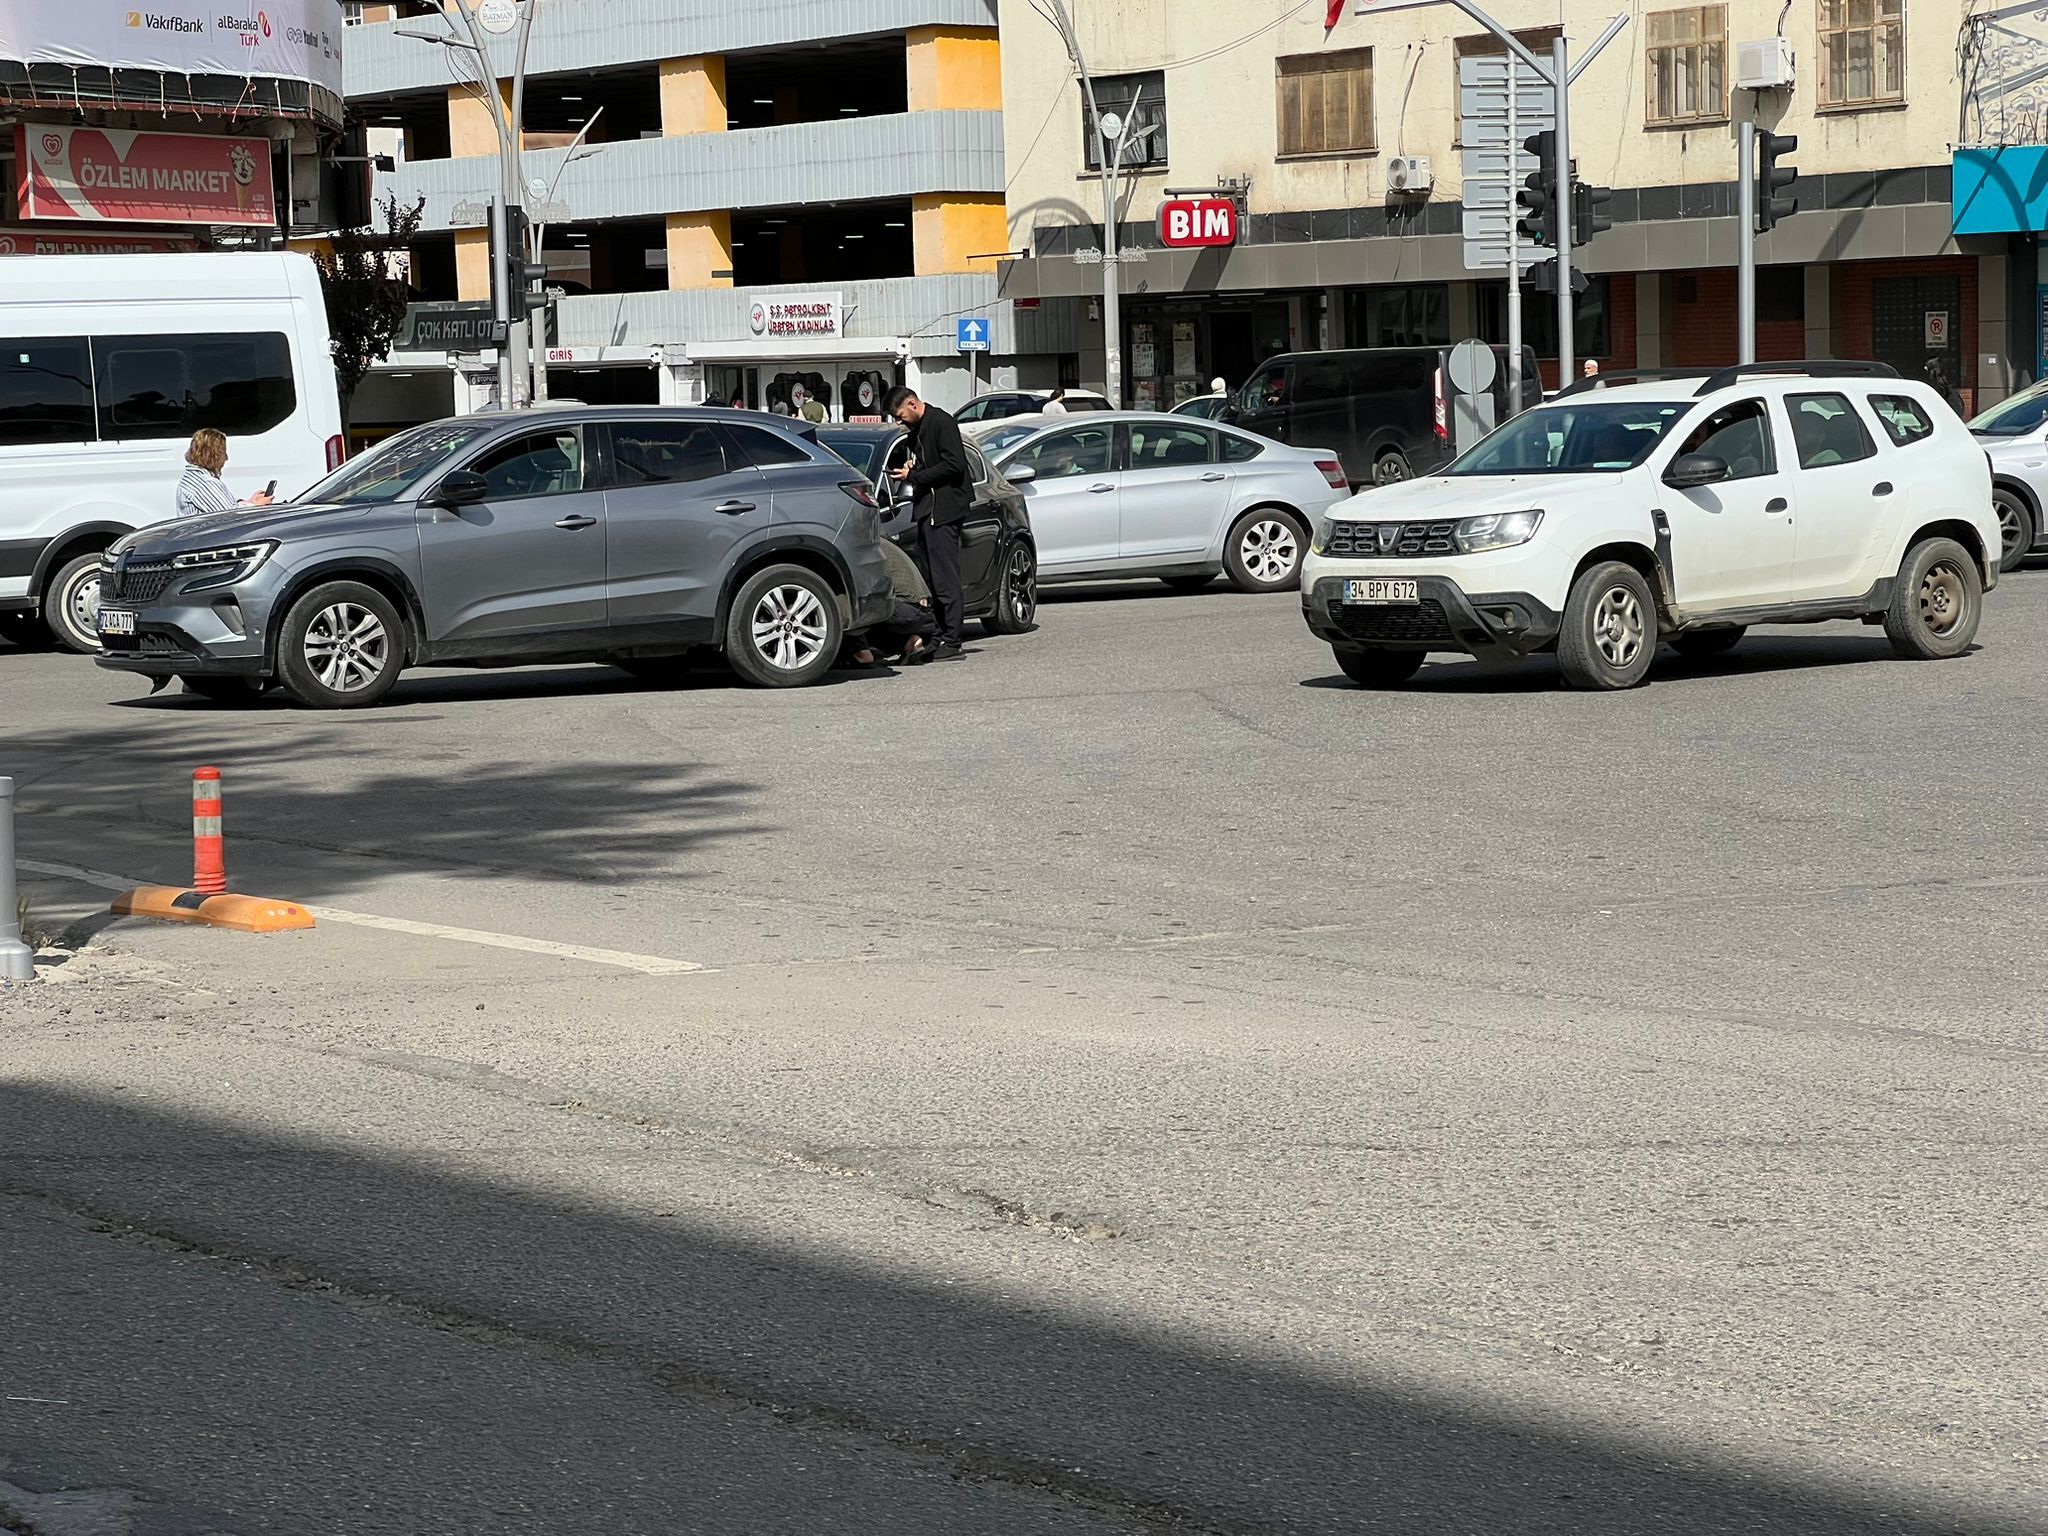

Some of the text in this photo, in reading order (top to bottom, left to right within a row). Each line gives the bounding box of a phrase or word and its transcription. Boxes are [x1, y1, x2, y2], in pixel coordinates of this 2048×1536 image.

[145, 14, 204, 32] VakıfBank
[217, 16, 258, 30] alBaraka
[240, 33, 259, 46] Türk
[80, 157, 230, 193] ÖZLEM MARKET
[1170, 201, 1229, 239] BİM
[417, 321, 440, 344] ÇOK
[443, 320, 475, 338] KATLI
[797, 319, 835, 332] KADINLAR
[1351, 582, 1415, 599] 34 BPY 672
[121, 613, 132, 629] 777
